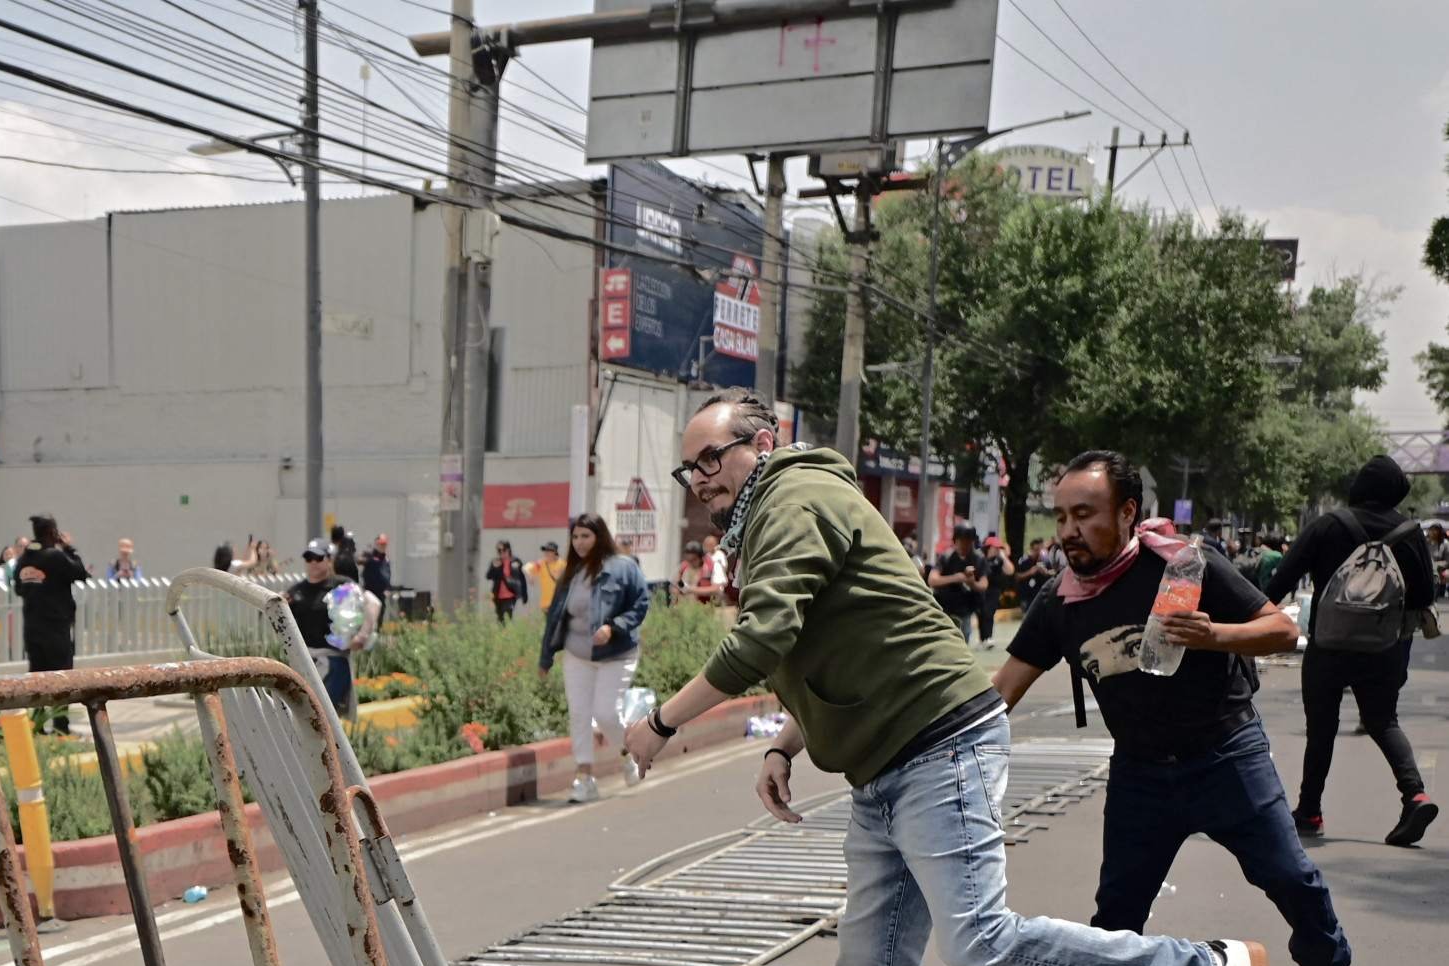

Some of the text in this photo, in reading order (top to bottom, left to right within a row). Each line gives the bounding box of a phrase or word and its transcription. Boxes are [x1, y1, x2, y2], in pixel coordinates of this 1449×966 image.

[1006, 163, 1082, 192] OTEL
[607, 303, 623, 324] E
[714, 294, 759, 331] FERRETE
